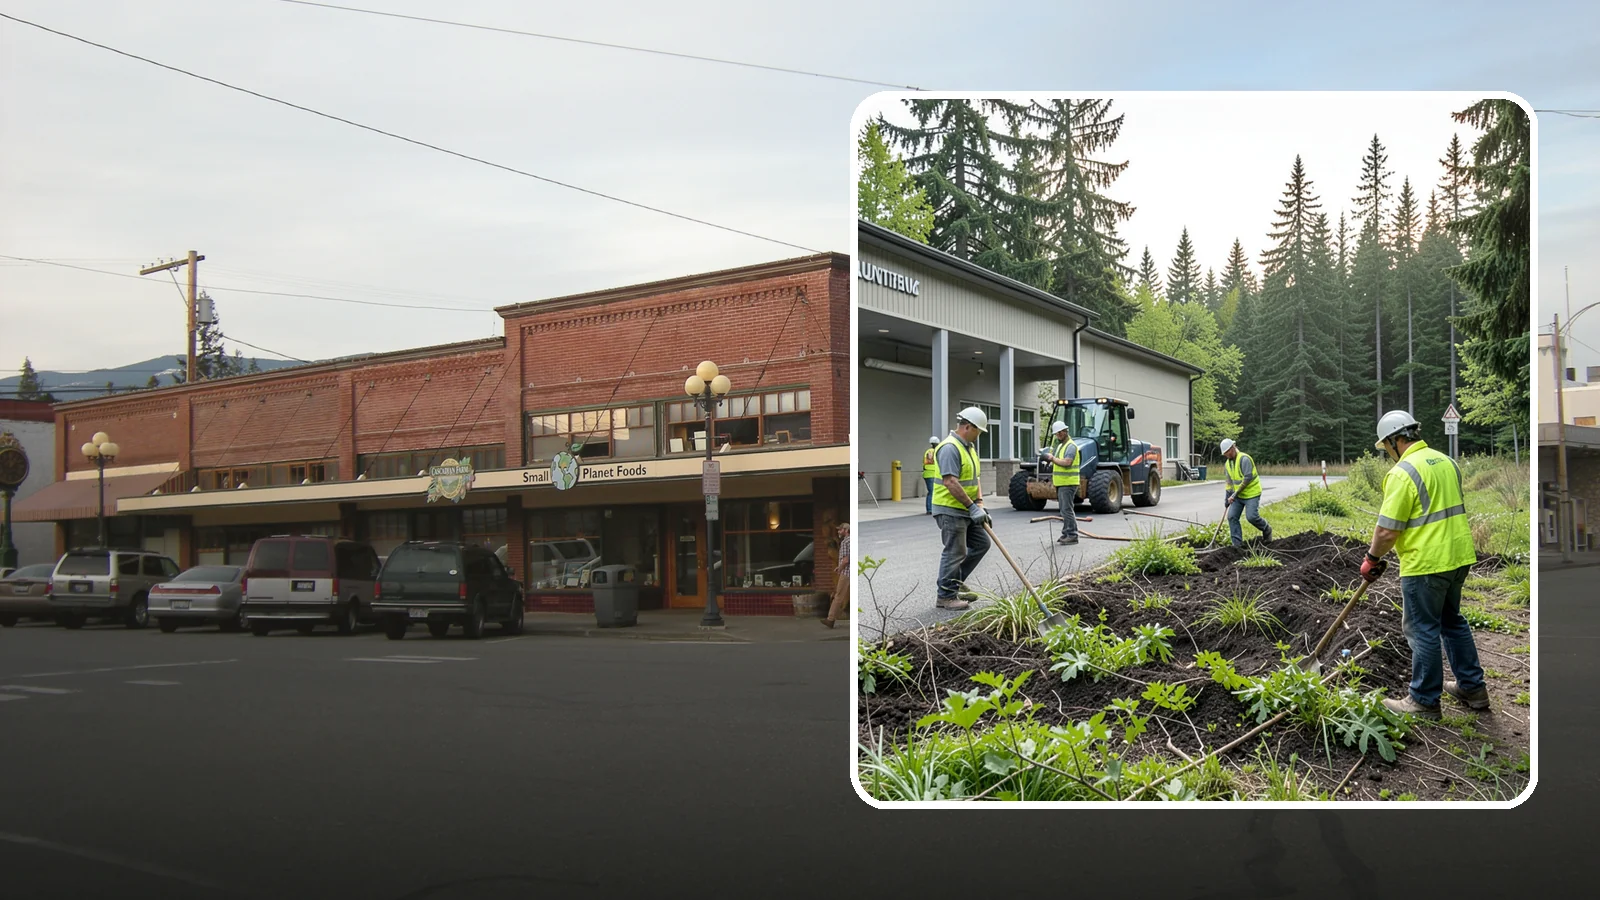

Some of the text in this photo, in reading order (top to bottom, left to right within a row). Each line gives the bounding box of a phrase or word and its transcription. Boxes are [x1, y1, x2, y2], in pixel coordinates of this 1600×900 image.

[523, 464, 647, 483] Small Planet Foods
